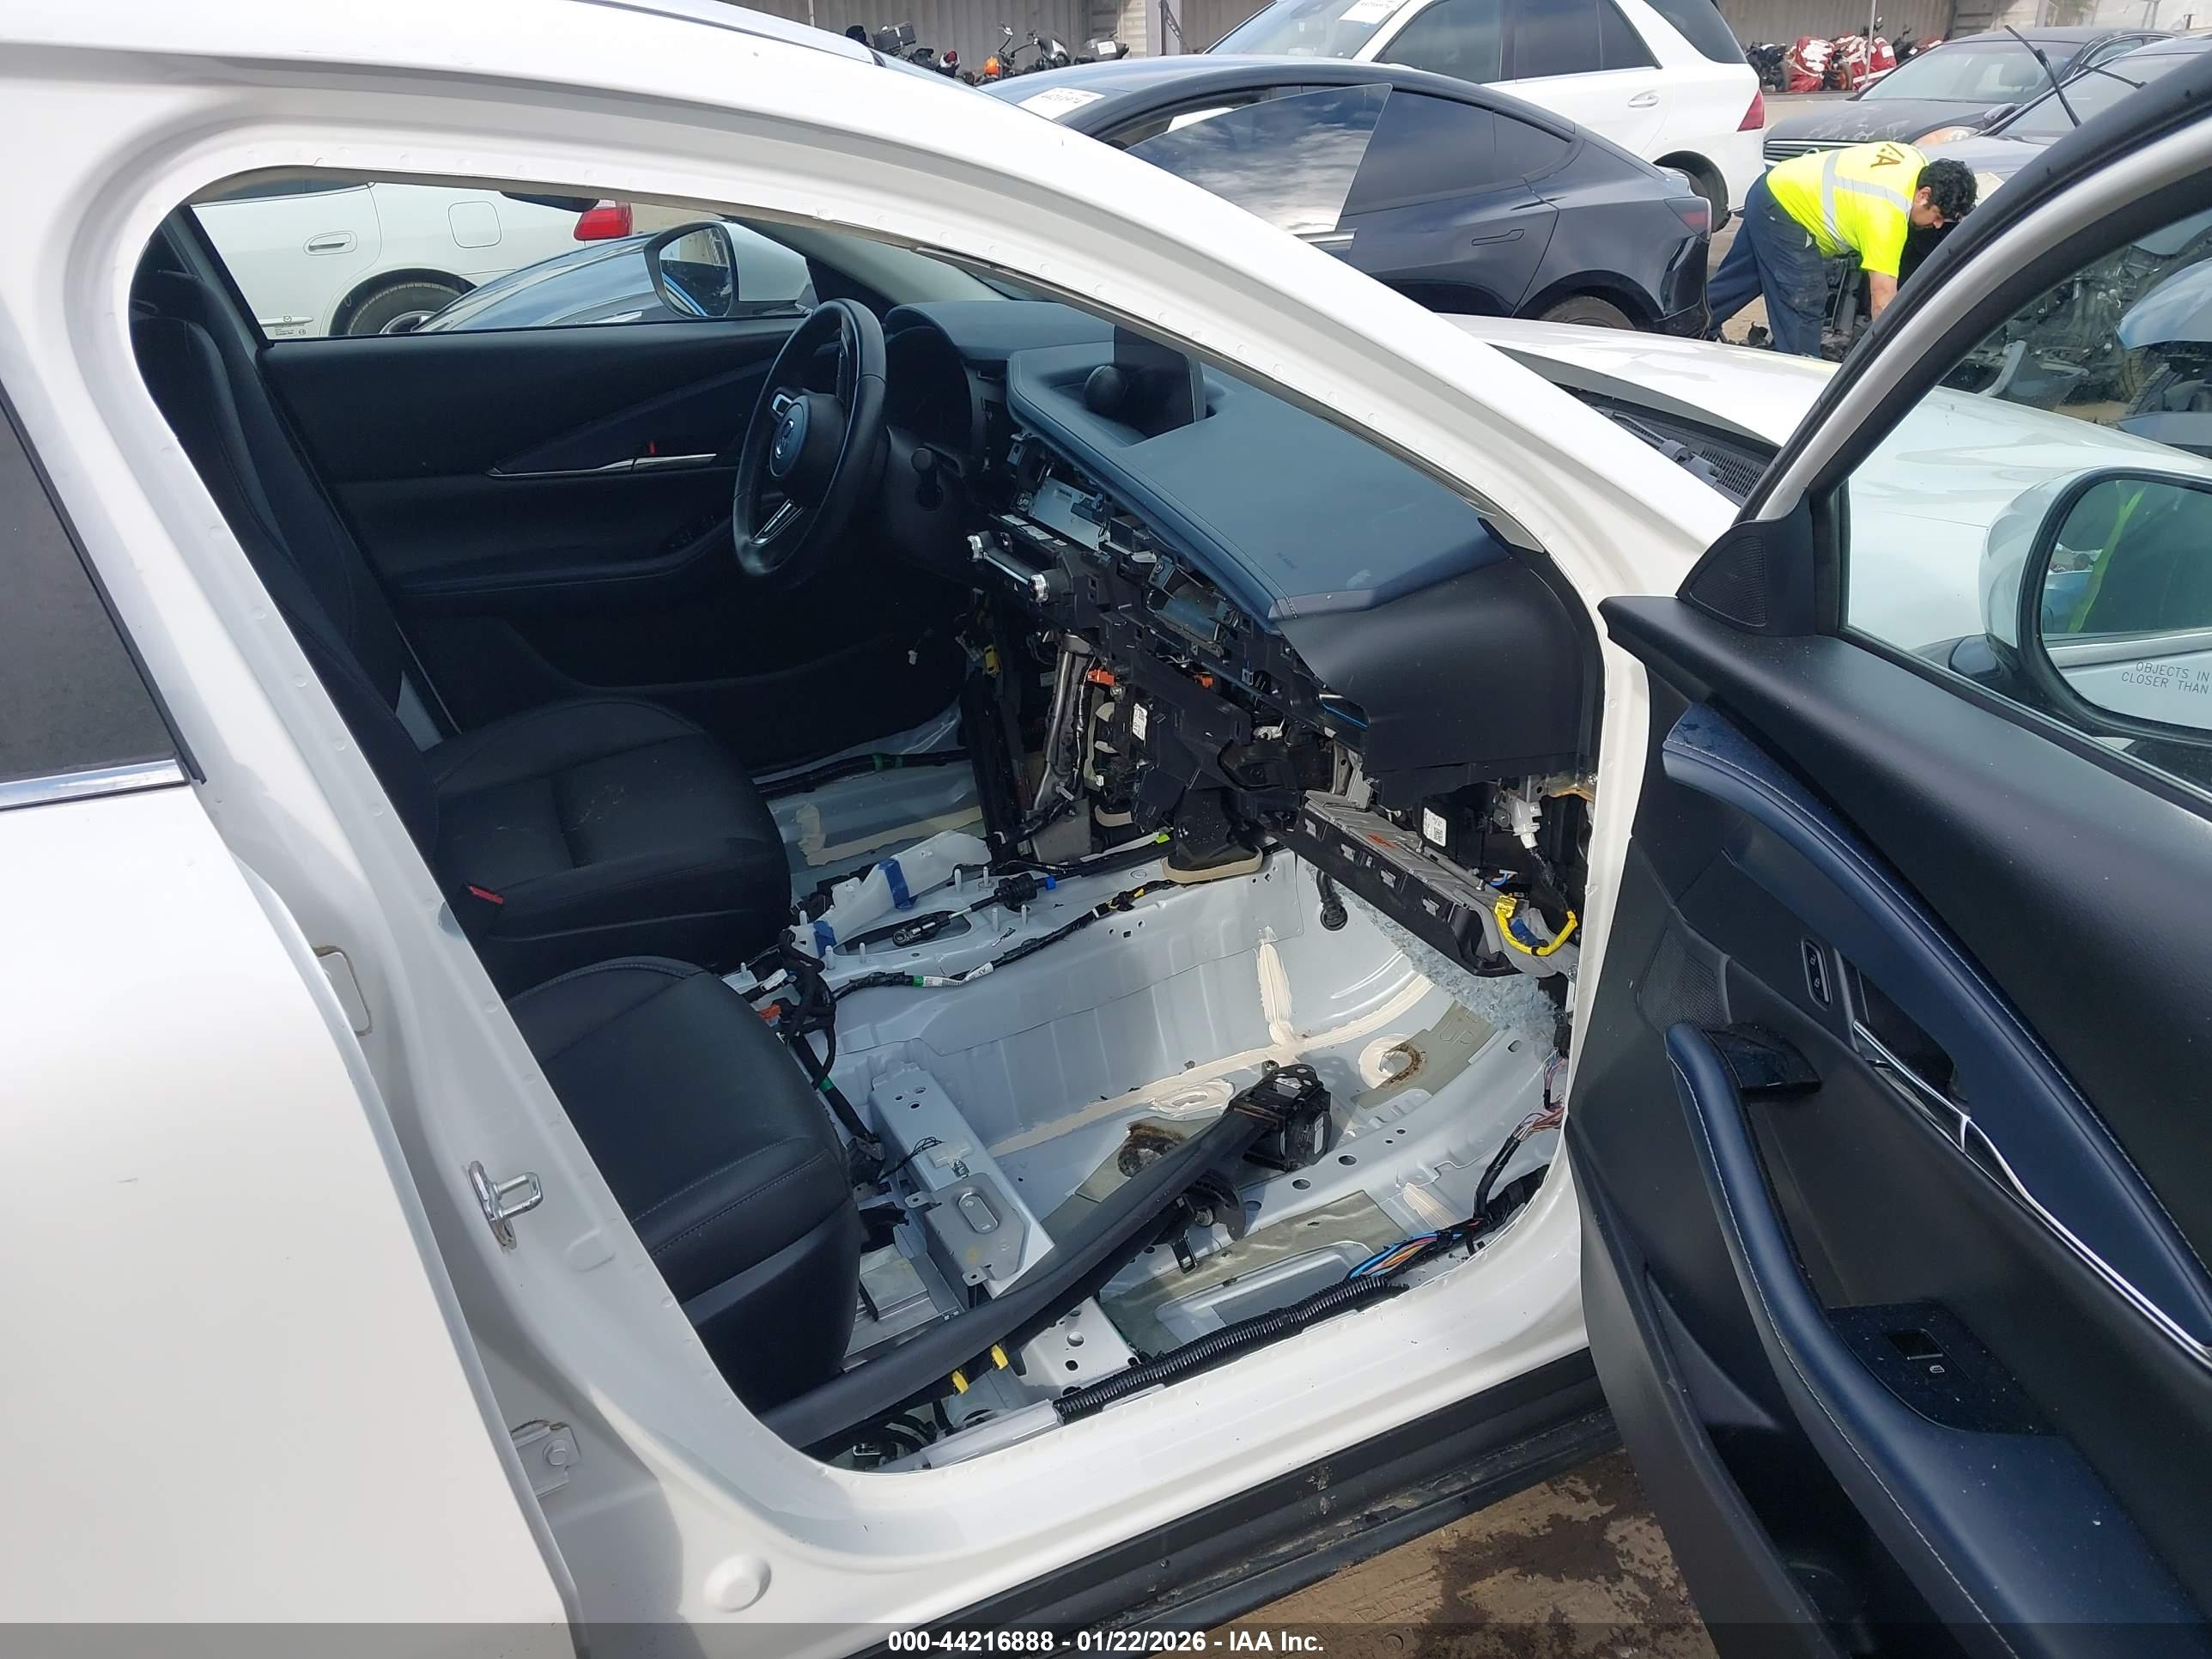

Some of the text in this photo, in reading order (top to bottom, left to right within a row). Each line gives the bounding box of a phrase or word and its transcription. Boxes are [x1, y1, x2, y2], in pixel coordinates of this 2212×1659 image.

[2136, 661, 2210, 683] OBJECTS IN
[2121, 672, 2209, 695] CLOSER THAN
